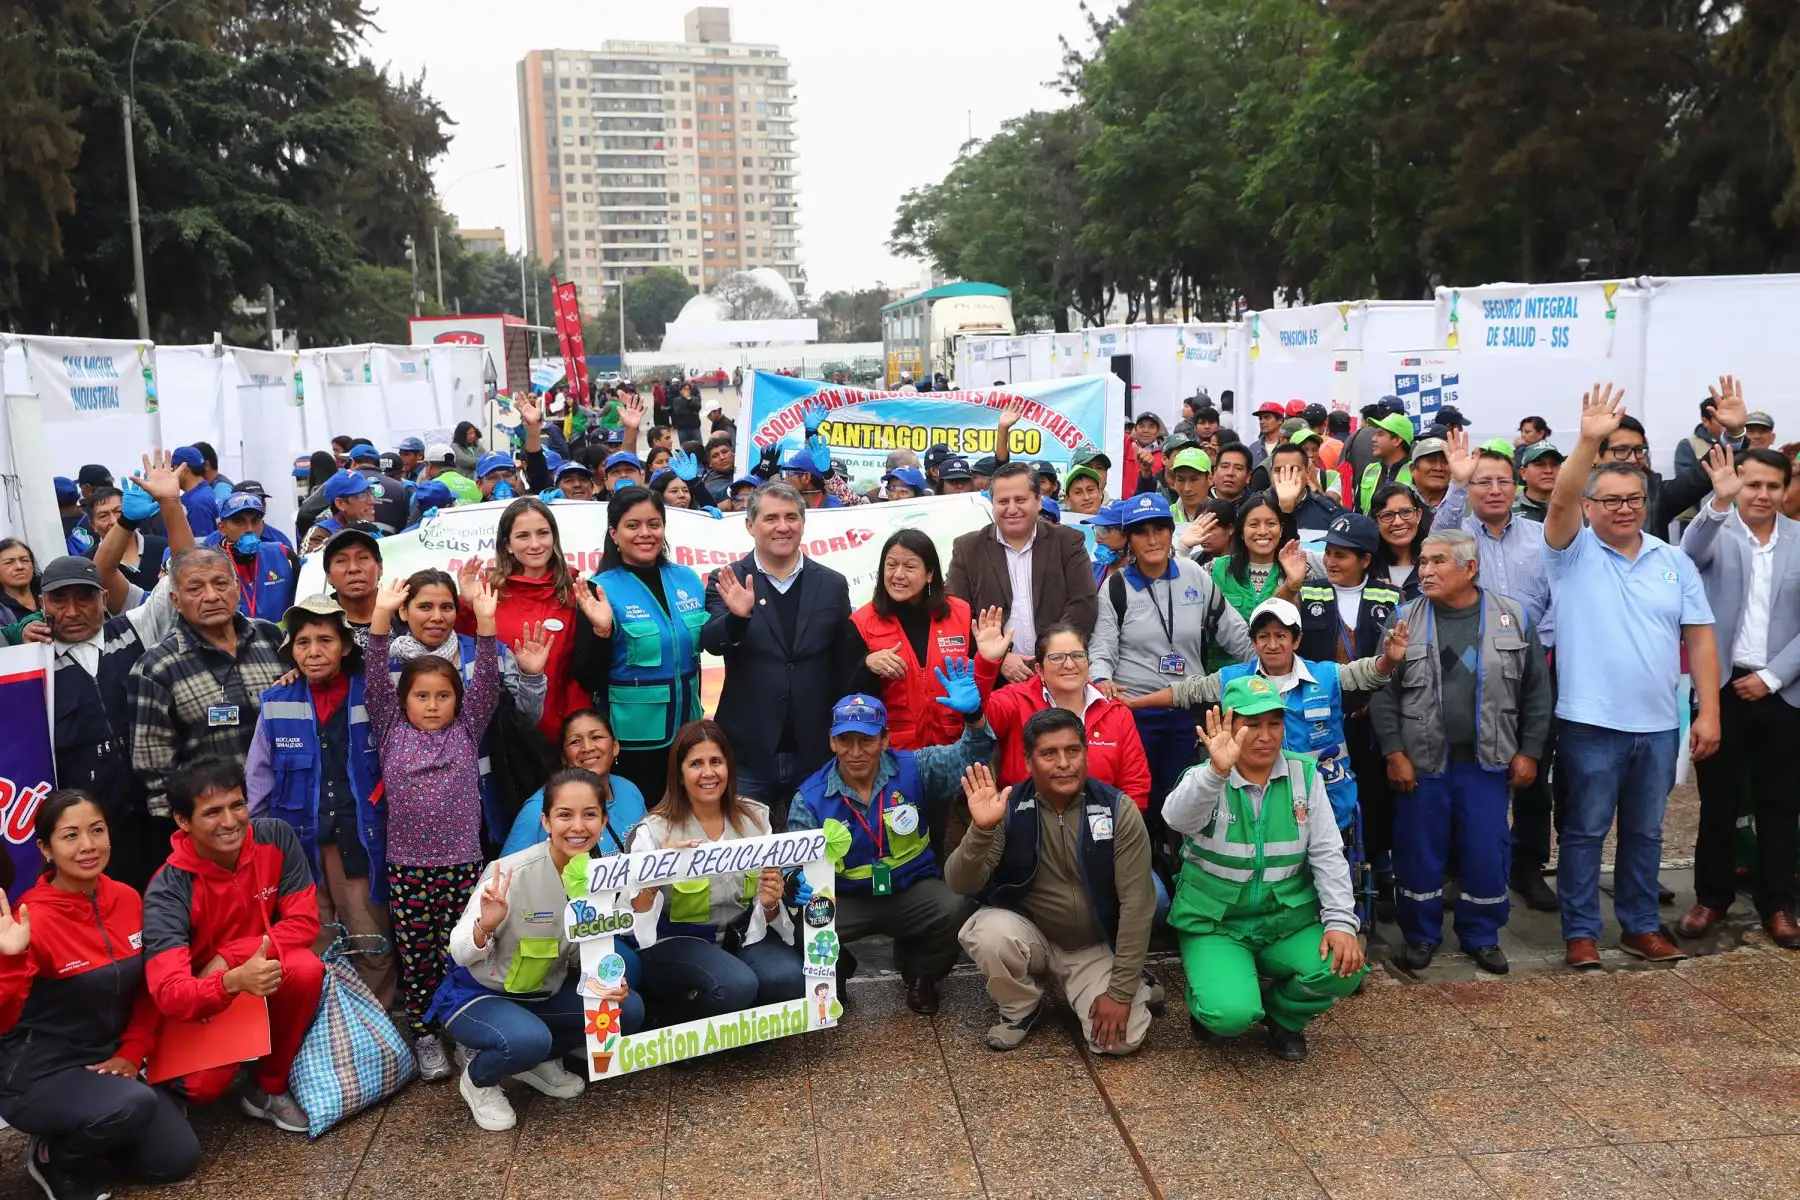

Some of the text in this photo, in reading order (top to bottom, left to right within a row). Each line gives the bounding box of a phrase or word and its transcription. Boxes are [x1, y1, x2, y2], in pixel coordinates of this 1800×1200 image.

[1482, 296, 1578, 319] SEGURO INTEGRAL
[1279, 327, 1307, 346] PENSIÓN
[1486, 326, 1500, 346] DE
[1502, 326, 1536, 347] SALUD
[1551, 326, 1569, 347] SIS
[62, 355, 119, 379] SAN MIGUEL
[1397, 377, 1410, 388] SIS
[1421, 373, 1432, 384] SIS
[70, 385, 120, 411] INDUSTRIAS
[845, 387, 866, 404] DE
[1422, 396, 1434, 406] SIS
[1443, 390, 1458, 402] SIS
[817, 420, 1042, 455] SANTIAGO DE SUCO
[862, 460, 875, 468] DE
[675, 529, 873, 566] RECIDORES
[677, 601, 702, 613] LIMA
[590, 834, 826, 893] DÍA DEL RECICLADOR
[570, 900, 597, 925] Yo
[568, 909, 634, 939] reciclo
[803, 966, 836, 977] recicla
[618, 1000, 809, 1072] Gestion Ambiental
